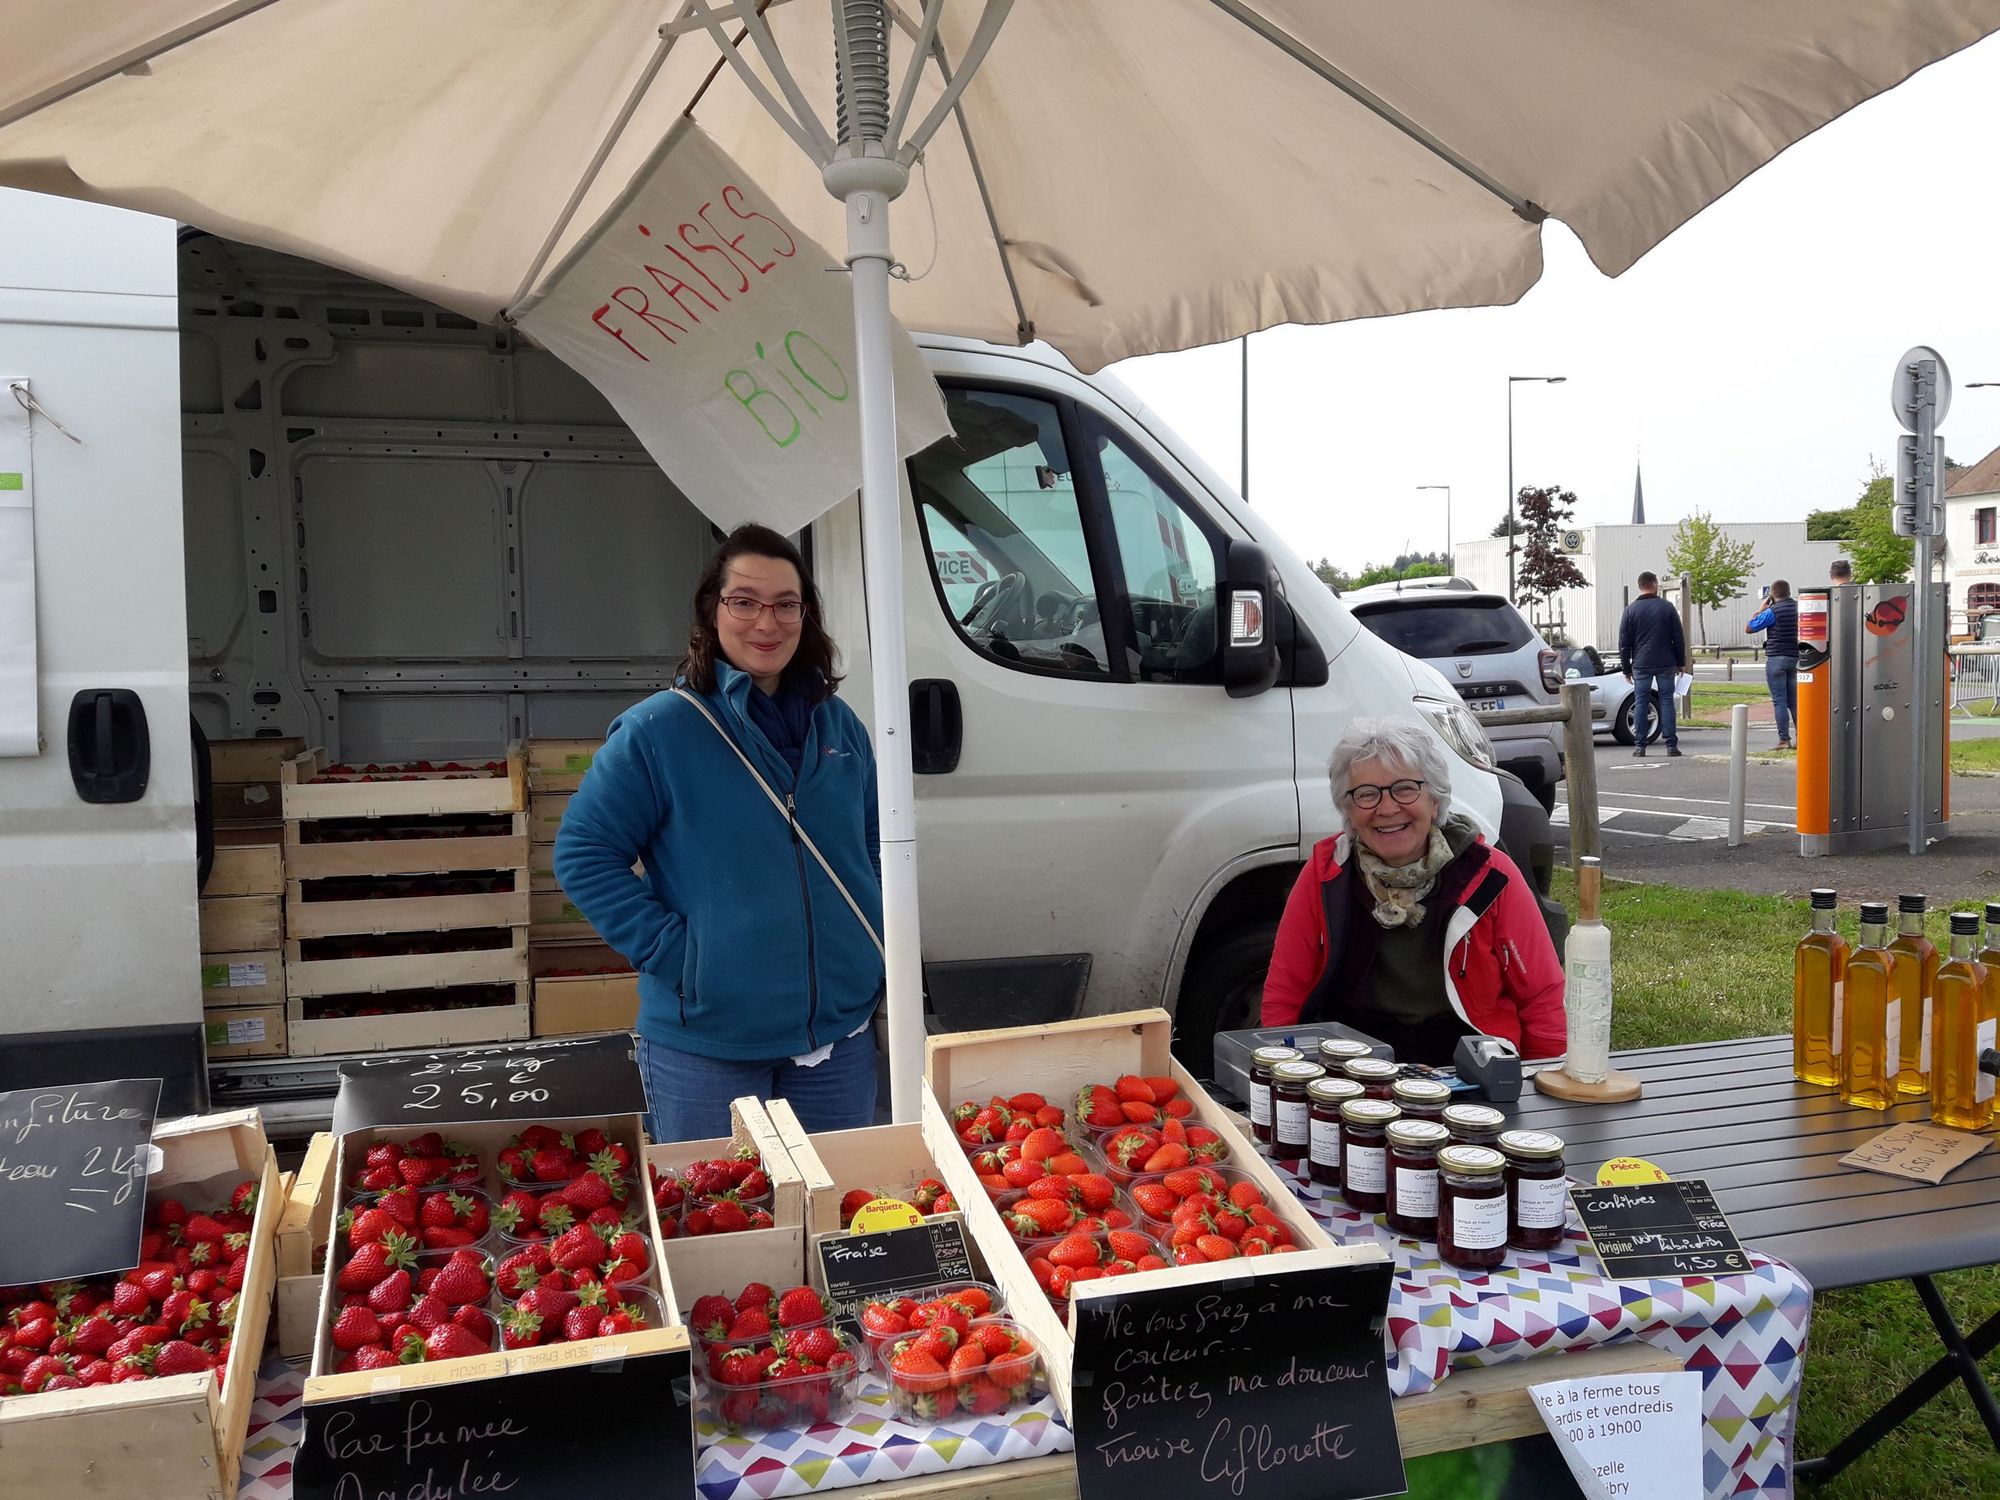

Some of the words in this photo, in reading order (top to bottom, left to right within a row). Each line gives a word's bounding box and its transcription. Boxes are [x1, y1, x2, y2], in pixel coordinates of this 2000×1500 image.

[0, 1092, 143, 1144] nfiture
[866, 1203, 903, 1214] Barquette
[829, 1242, 888, 1263] Fraise
[1599, 1240, 1634, 1254] Origine
[1674, 1256, 1718, 1271] 4,50
[1725, 1254, 1743, 1268] €
[1293, 1294, 1349, 1310] ma
[1228, 1373, 1267, 1396] ma
[1277, 1356, 1374, 1387] douceur
[1557, 1390, 1565, 1405] à
[1568, 1390, 1579, 1402] la
[1583, 1386, 1623, 1400] ferme
[1628, 1383, 1660, 1396] tous
[1586, 1406, 1599, 1419] et
[1603, 1400, 1674, 1417] vendredis
[1588, 1425, 1595, 1439] à
[1600, 1419, 1642, 1437] 19h00
